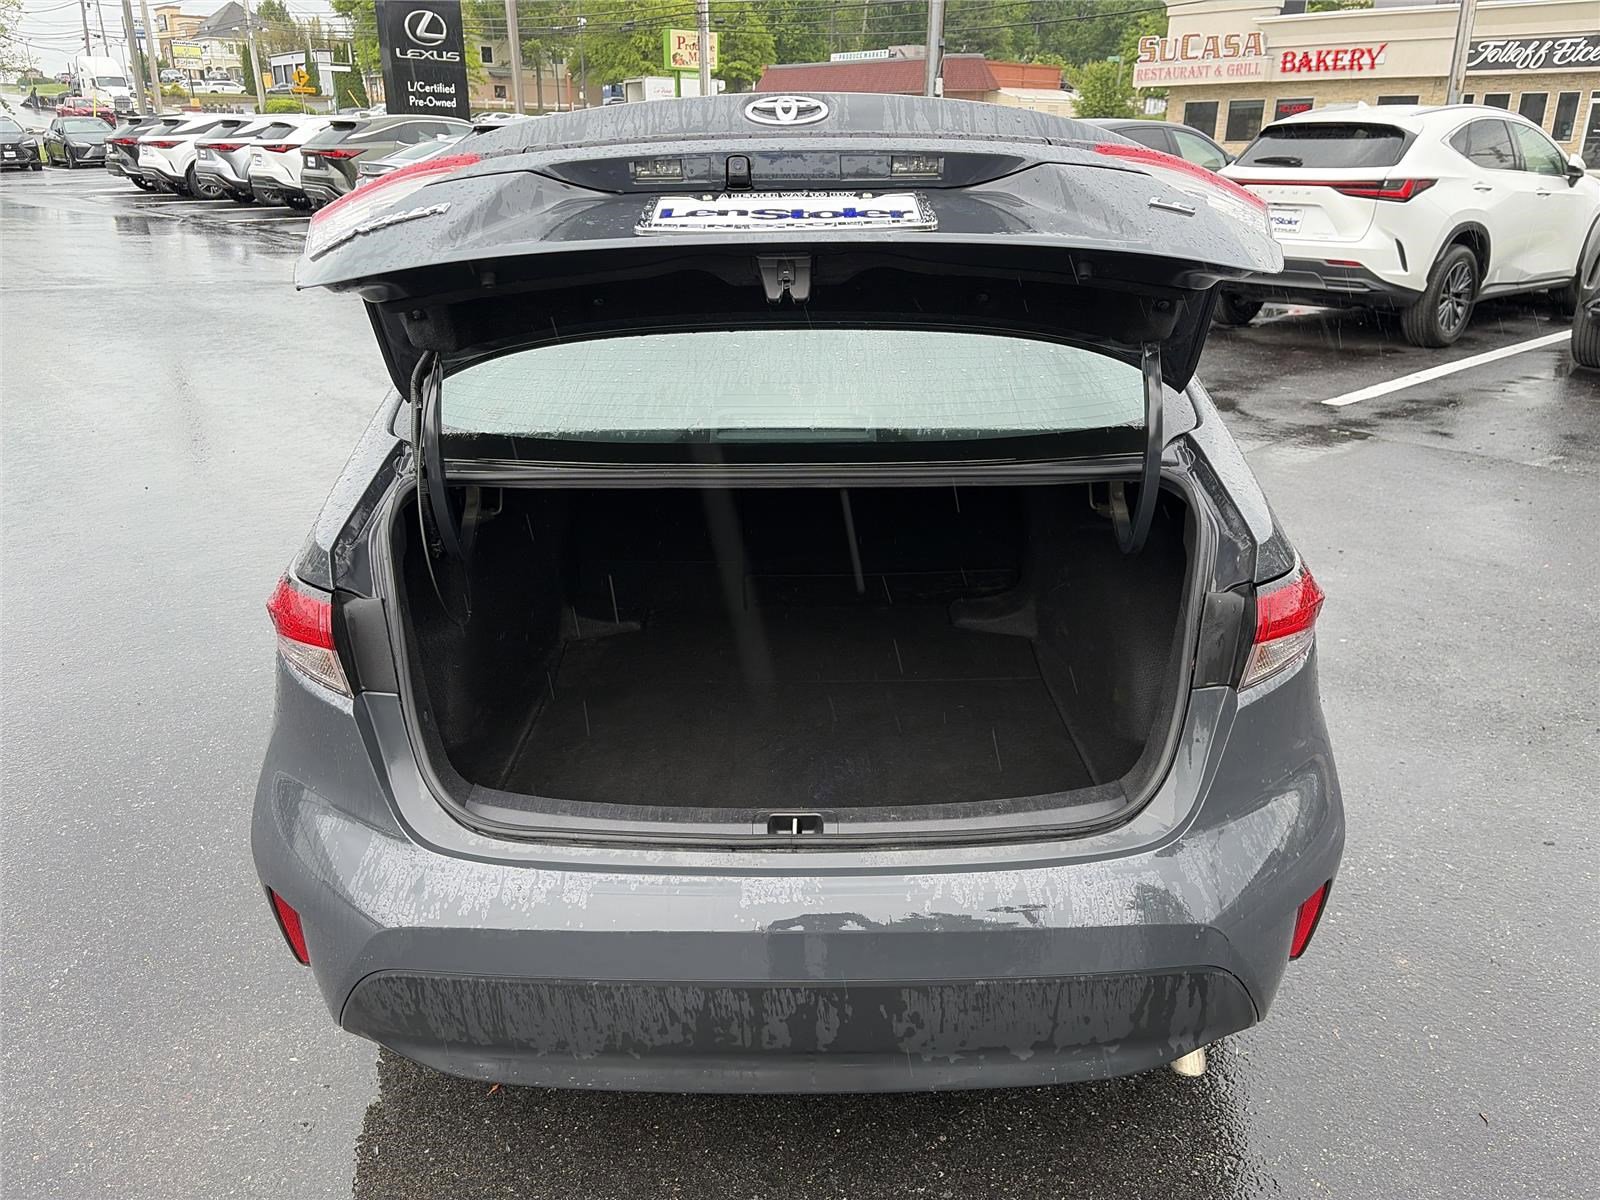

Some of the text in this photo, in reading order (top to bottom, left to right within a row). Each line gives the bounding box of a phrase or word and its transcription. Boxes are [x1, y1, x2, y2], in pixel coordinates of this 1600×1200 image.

[677, 36, 715, 52] Prode
[396, 48, 460, 62] LEXUS
[1280, 42, 1388, 73] BAKERY
[1136, 61, 1262, 82] RESTAURANT & GRILL
[407, 81, 456, 94] L/Certified
[409, 95, 457, 108] Pre-Owned
